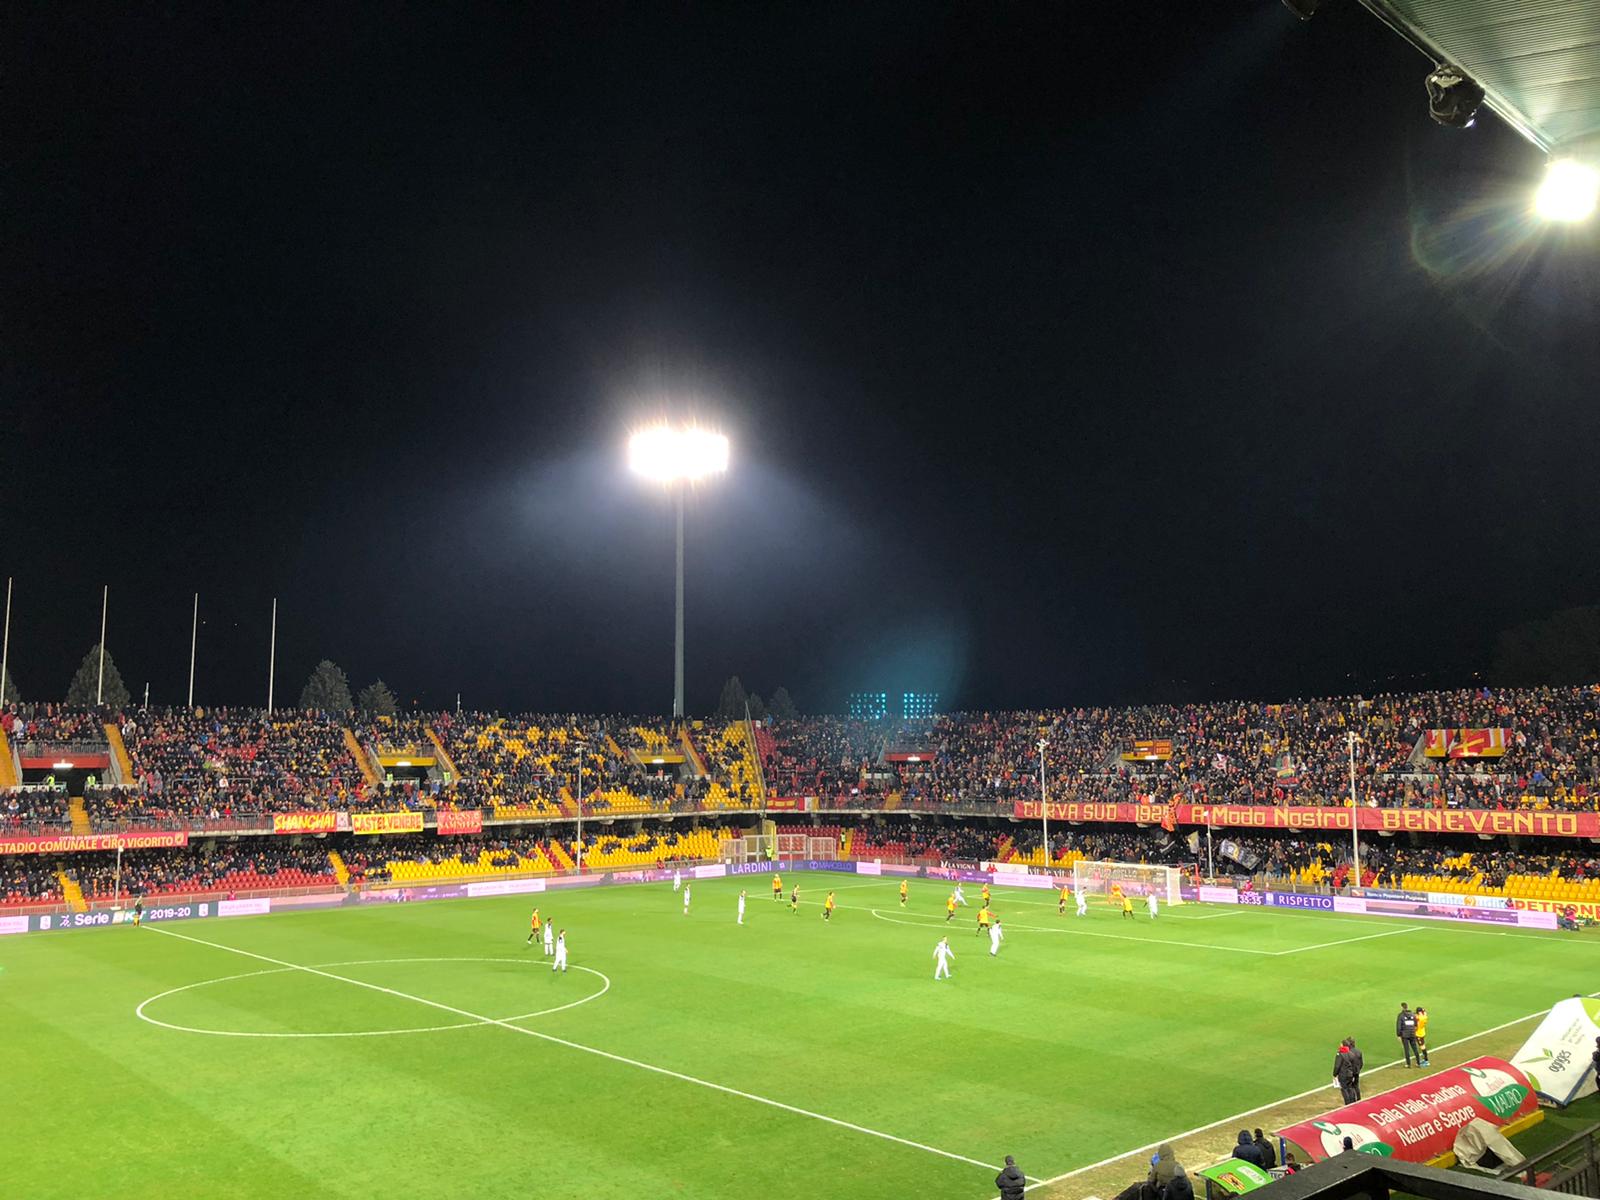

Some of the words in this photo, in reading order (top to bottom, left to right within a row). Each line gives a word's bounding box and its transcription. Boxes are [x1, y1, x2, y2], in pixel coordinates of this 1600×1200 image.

[274, 813, 336, 832] SHANGHAI
[1023, 801, 1078, 819] CURVA
[1083, 803, 1118, 821] SUD
[1212, 807, 1266, 825] Modo
[1274, 808, 1349, 827] Nostro
[1381, 810, 1578, 835] BENEVENTO
[38, 839, 97, 852] COMUNALE
[101, 837, 125, 849] CIRO
[128, 835, 173, 848] VIGORITO
[731, 861, 772, 874] LARDINI
[1278, 895, 1332, 908] RISPETTO
[74, 911, 109, 926] Serie
[150, 906, 191, 920] 2019-20
[1367, 1105, 1404, 1127] Dalla
[1398, 1094, 1430, 1118] Valle
[1425, 1084, 1466, 1107] Caudina
[1488, 1089, 1522, 1116] MAURO
[1396, 1122, 1435, 1147] Natura
[1435, 1121, 1443, 1131] e
[1439, 1103, 1476, 1131] Sapore
